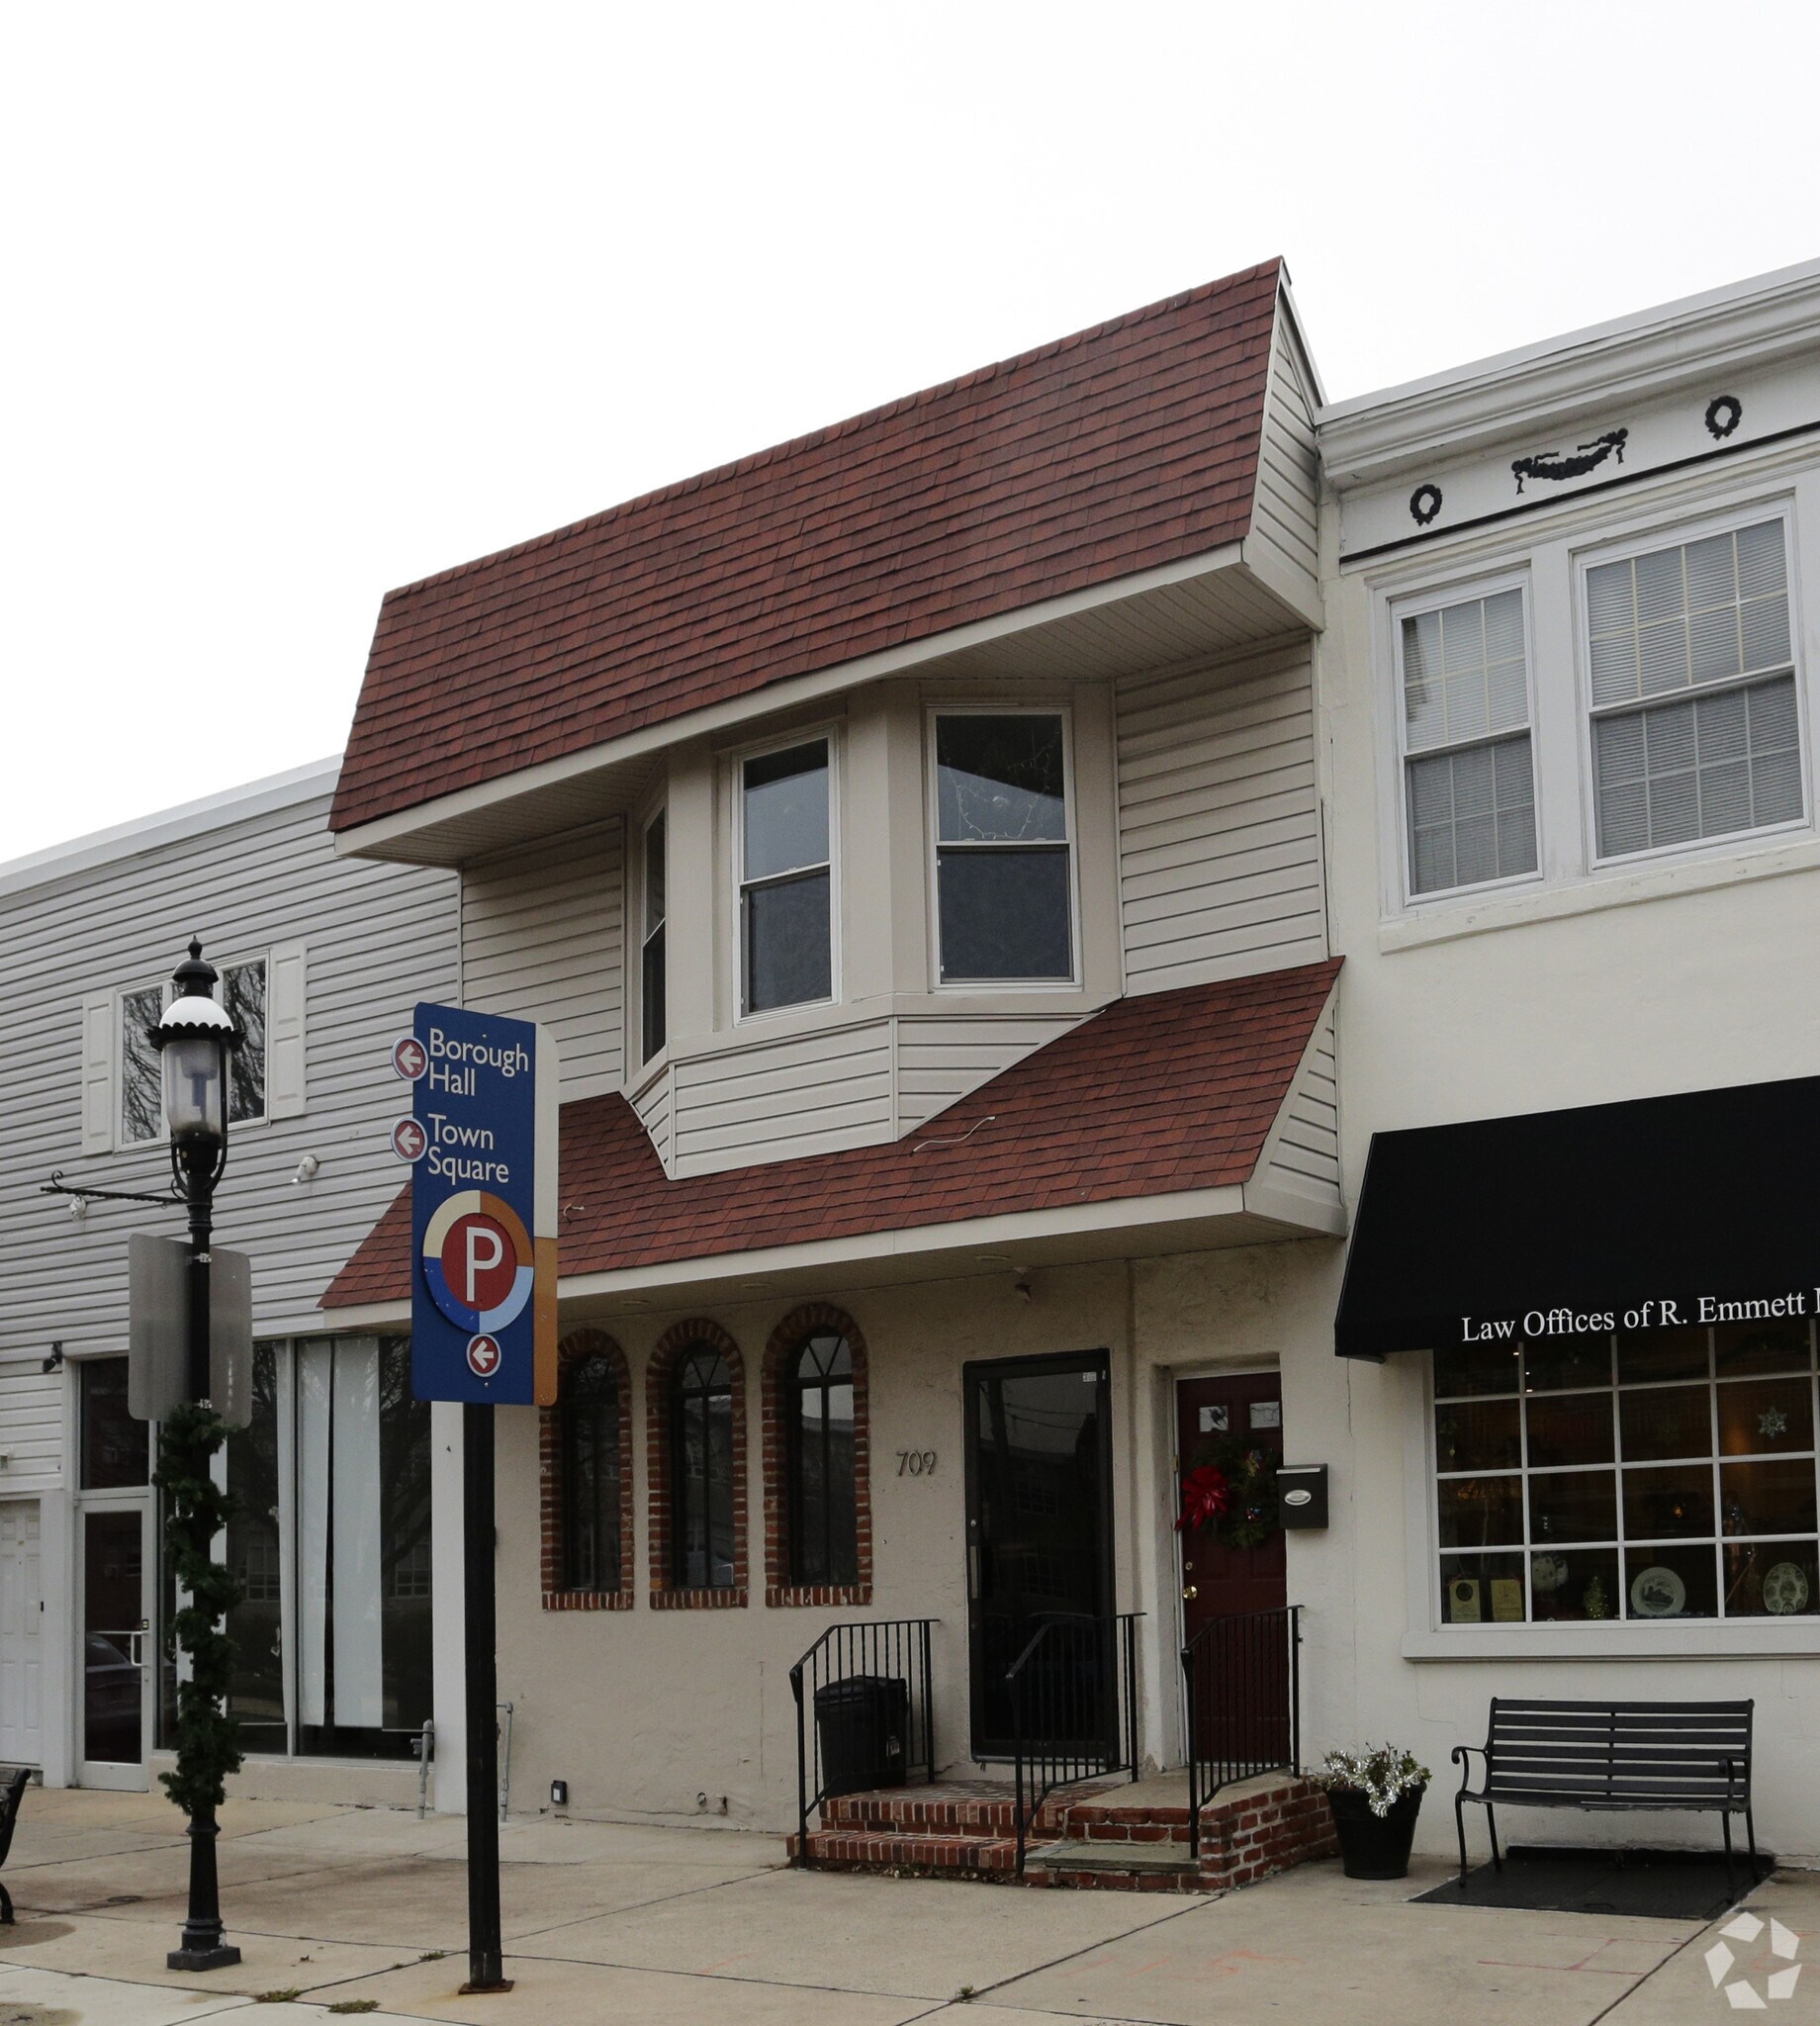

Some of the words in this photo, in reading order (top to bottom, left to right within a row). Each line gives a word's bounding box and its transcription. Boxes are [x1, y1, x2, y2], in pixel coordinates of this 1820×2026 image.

[429, 1028, 529, 1077] Borough
[428, 1061, 476, 1096] Hall
[427, 1113, 494, 1150] Town
[427, 1148, 509, 1185] Square
[466, 1227, 503, 1302] P
[1462, 1317, 1516, 1341] Law
[1523, 1308, 1615, 1336] Offices
[1623, 1301, 1654, 1329] of
[1659, 1300, 1687, 1326] R.
[1697, 1291, 1806, 1323] Emmett
[896, 1450, 936, 1476] 709
